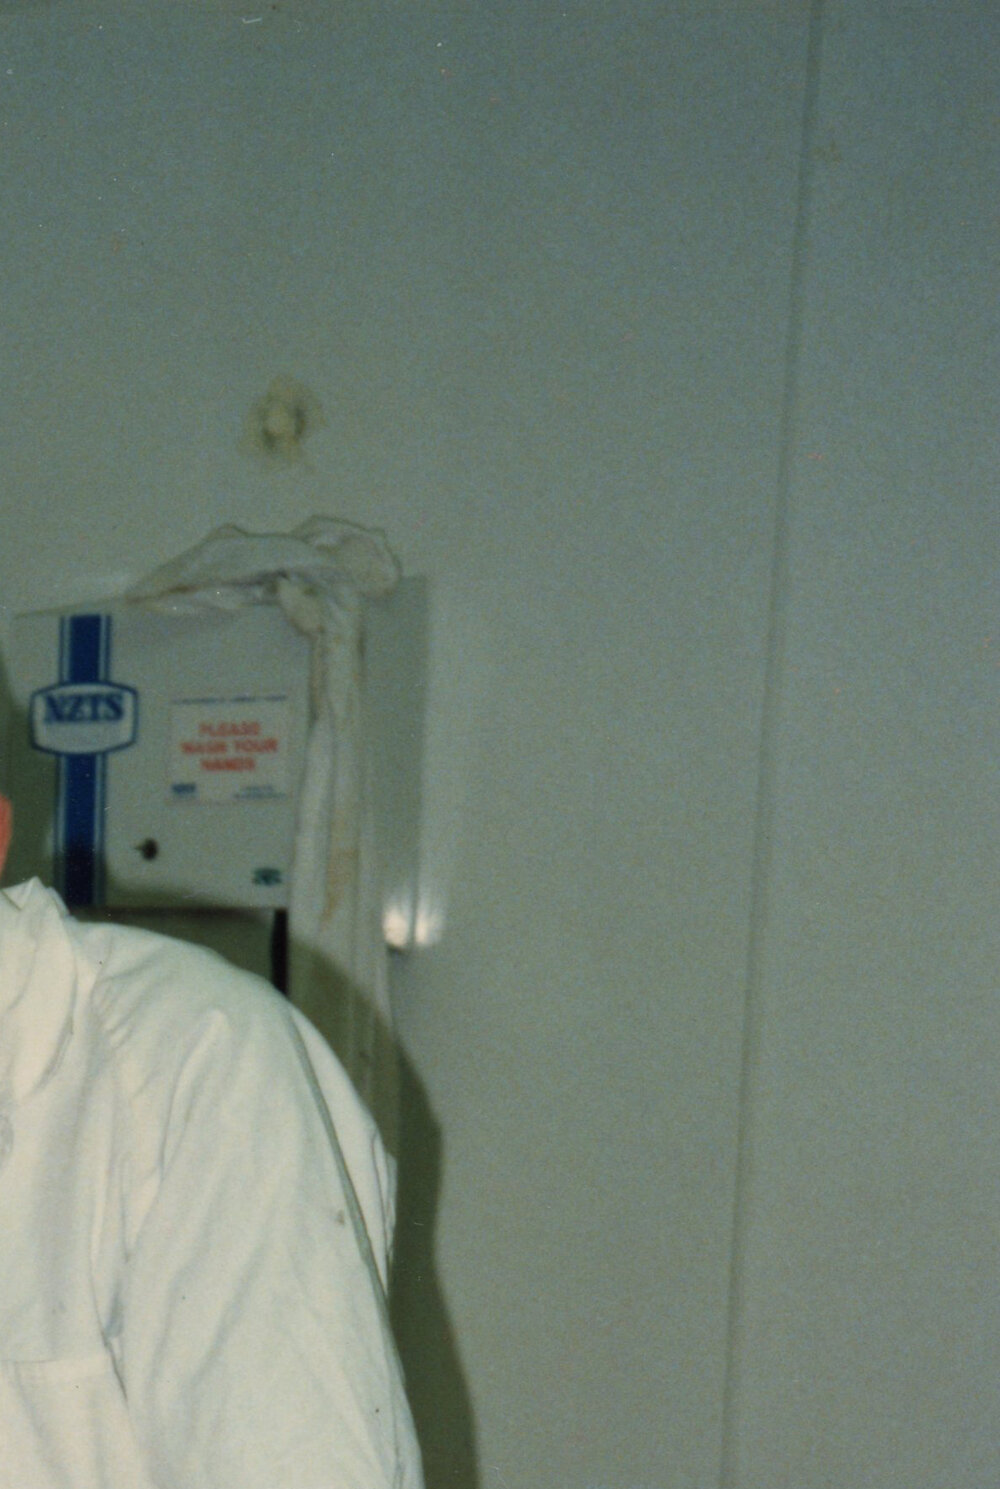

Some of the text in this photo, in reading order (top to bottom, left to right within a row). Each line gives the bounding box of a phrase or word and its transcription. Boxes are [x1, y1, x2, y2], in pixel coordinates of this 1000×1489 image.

[44, 694, 124, 723] NZTS
[198, 721, 261, 737] PLEASE
[180, 738, 278, 755] WASH YOUR
[200, 757, 256, 772] HANDS
